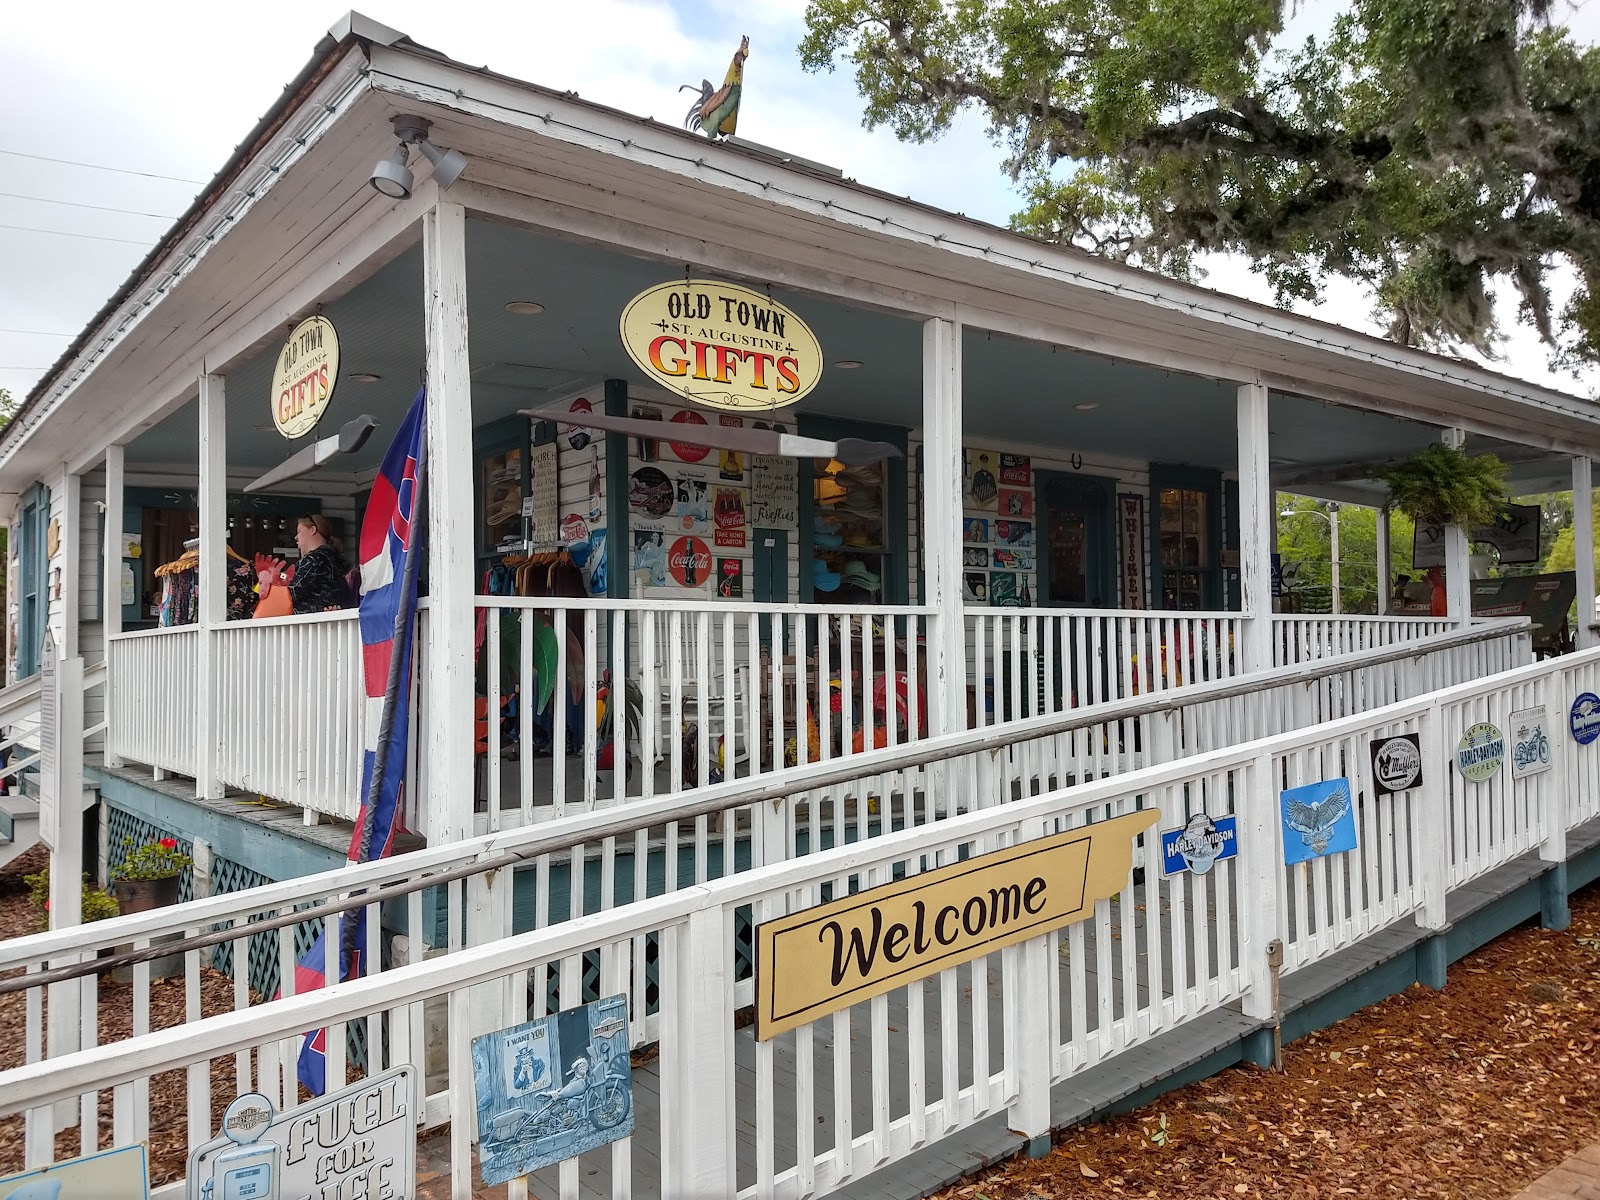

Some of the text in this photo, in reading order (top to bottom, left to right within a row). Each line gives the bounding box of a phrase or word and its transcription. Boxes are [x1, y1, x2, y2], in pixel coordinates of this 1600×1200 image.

[667, 292, 786, 338] OLD TOWN
[284, 325, 323, 373] OLD TOWN
[671, 322, 784, 352] ST. AUGUSTINE
[292, 354, 322, 380] AUGUSTINE
[648, 335, 801, 394] GIFTS
[278, 362, 329, 424] GIFTS
[773, 482, 794, 494] porch
[753, 506, 794, 524] fireflies
[715, 530, 744, 540] TAKE HOME
[722, 537, 743, 546] CARTON
[1391, 754, 1419, 774] Mufflers
[1459, 739, 1504, 770] HARLEY-DAVIDSON
[1474, 759, 1502, 776] SPEED
[818, 876, 1047, 987] Welcome
[511, 1033, 530, 1046] WANT
[531, 1028, 546, 1040] YOU
[286, 1080, 407, 1167] FUEL
[315, 1138, 375, 1185] FOR
